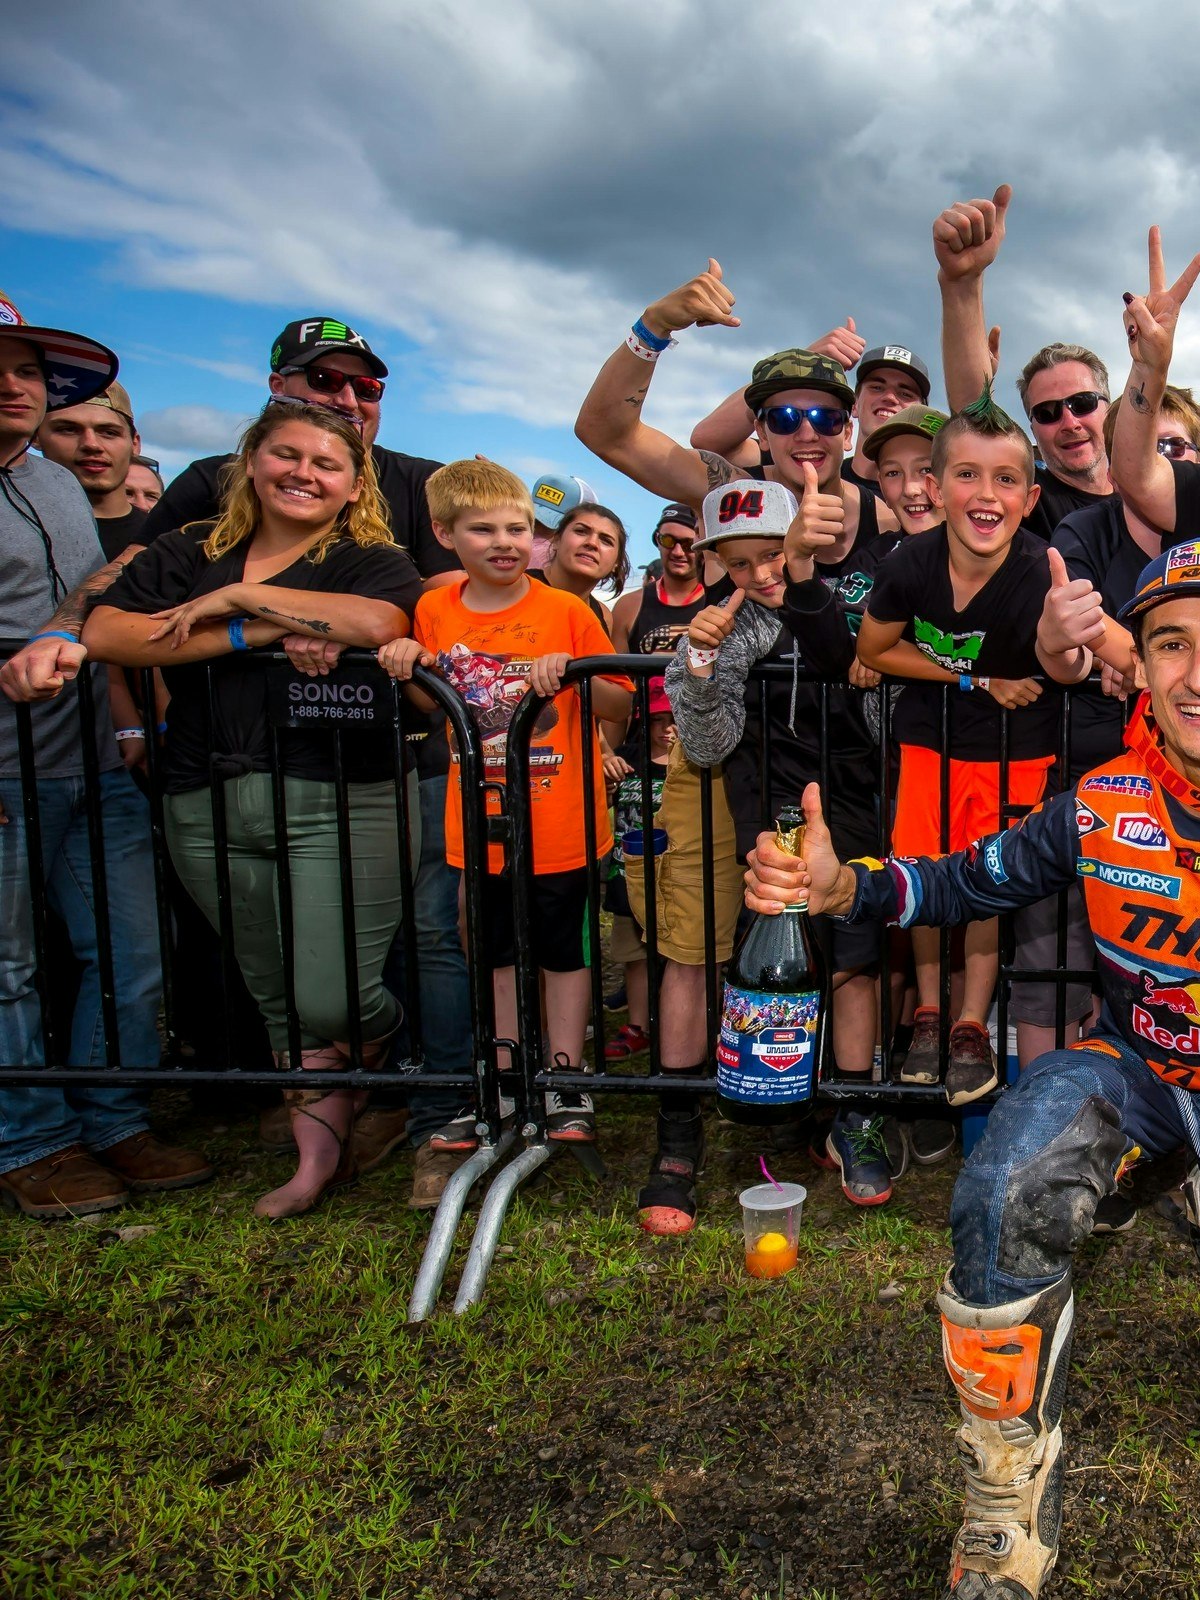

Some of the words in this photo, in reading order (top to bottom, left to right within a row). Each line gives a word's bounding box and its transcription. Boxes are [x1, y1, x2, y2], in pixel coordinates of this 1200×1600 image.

[886, 349, 909, 358] FOX
[541, 486, 562, 500] YETI
[718, 488, 764, 524] 94
[1169, 555, 1197, 570] Red
[504, 664, 532, 672] ATV
[288, 682, 374, 704] SONCO
[288, 705, 374, 719] 1-888-766-2615
[1084, 775, 1153, 791] PARTS
[1082, 783, 1152, 799] UNLIMITED
[1123, 820, 1163, 845] 100%
[1098, 864, 1172, 895] MOTOREX
[766, 1046, 799, 1054] UNADILLA
